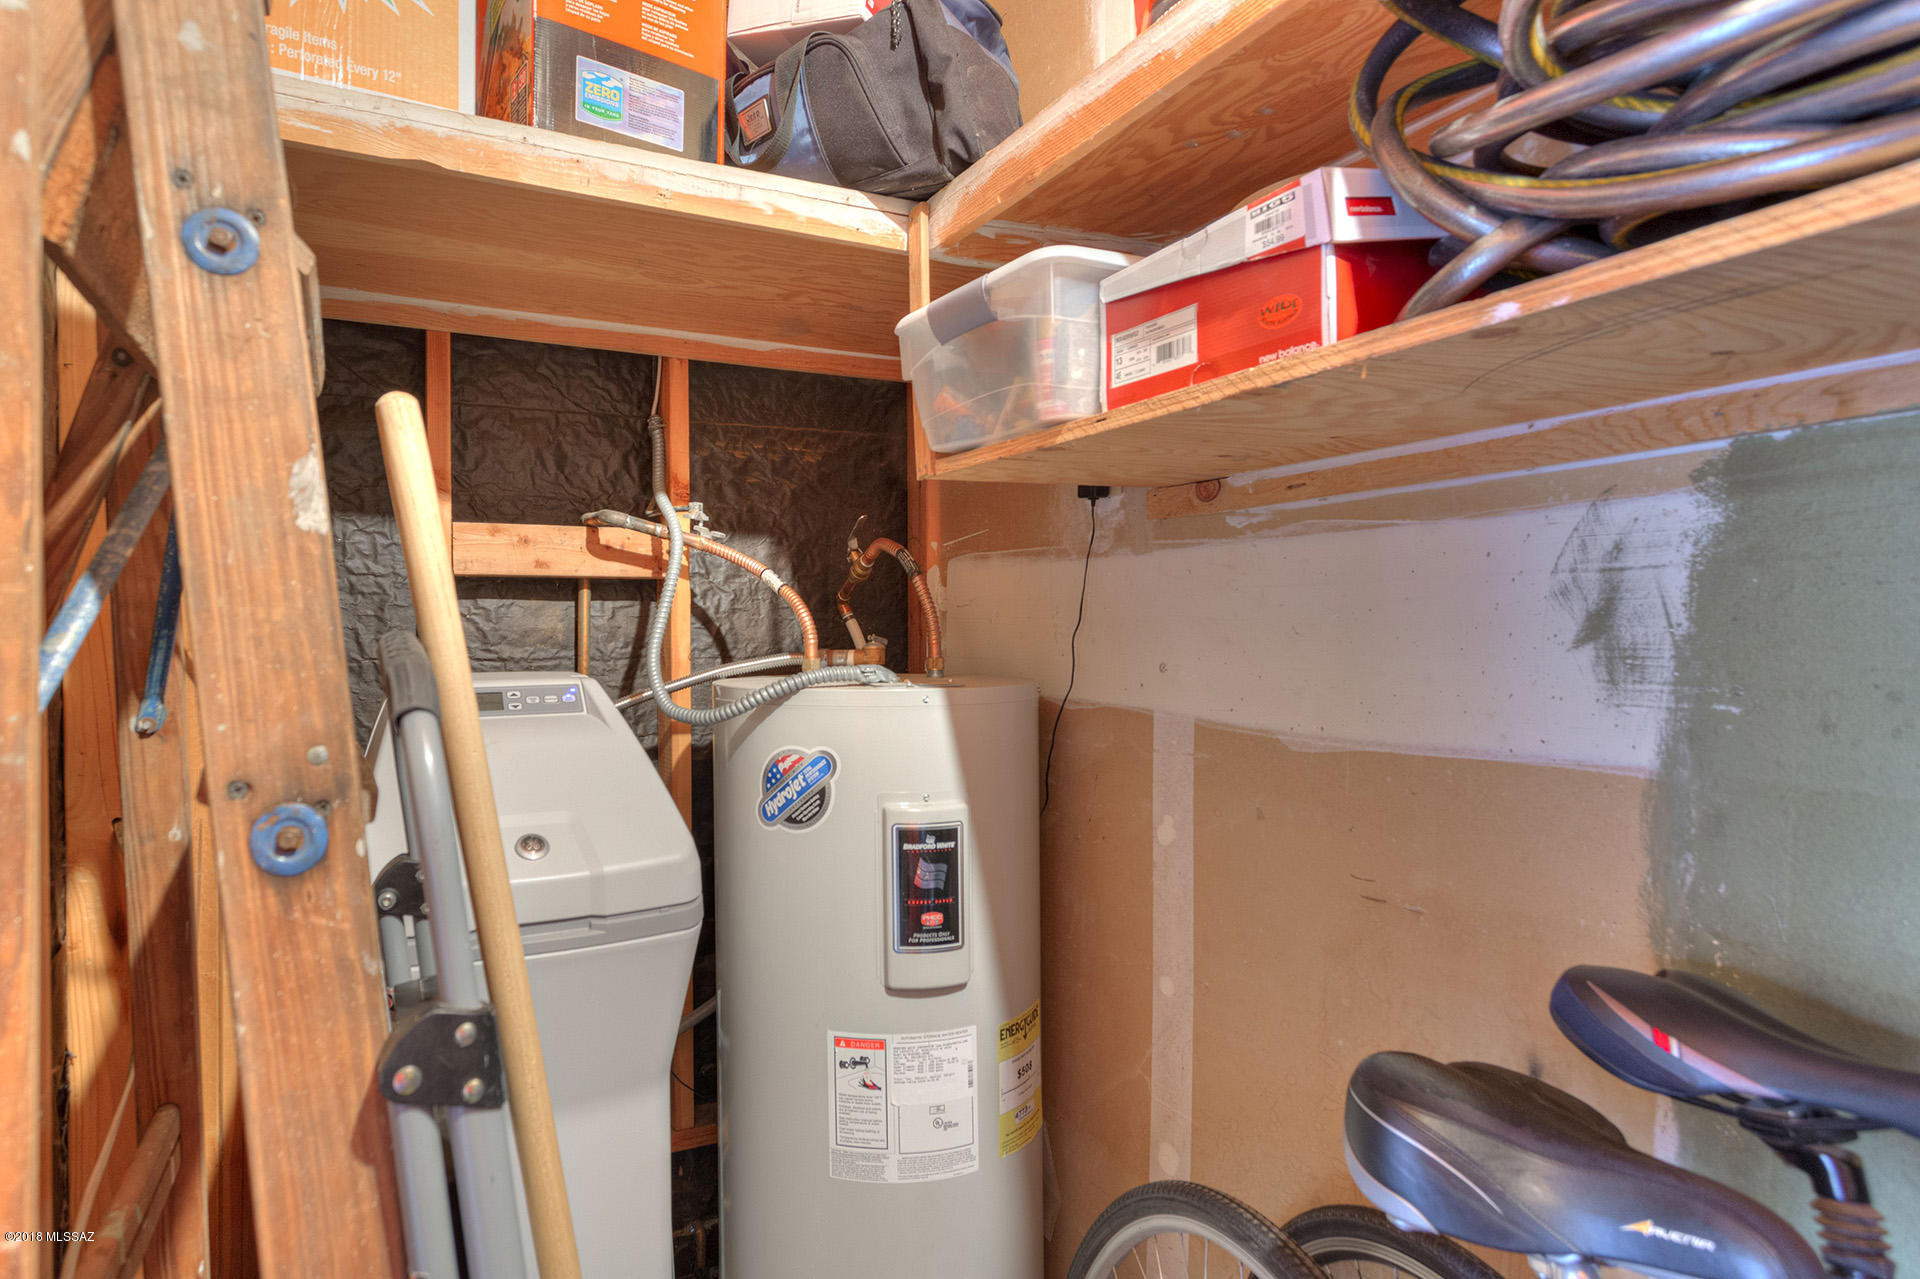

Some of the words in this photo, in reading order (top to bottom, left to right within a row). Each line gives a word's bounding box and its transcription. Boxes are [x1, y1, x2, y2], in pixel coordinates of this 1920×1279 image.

[264, 24, 300, 40] ragile
[303, 32, 337, 50] Items
[279, 43, 342, 70] Perforated
[346, 58, 378, 80] Every
[584, 81, 620, 102] ZERO
[764, 774, 806, 818] Hydrojet
